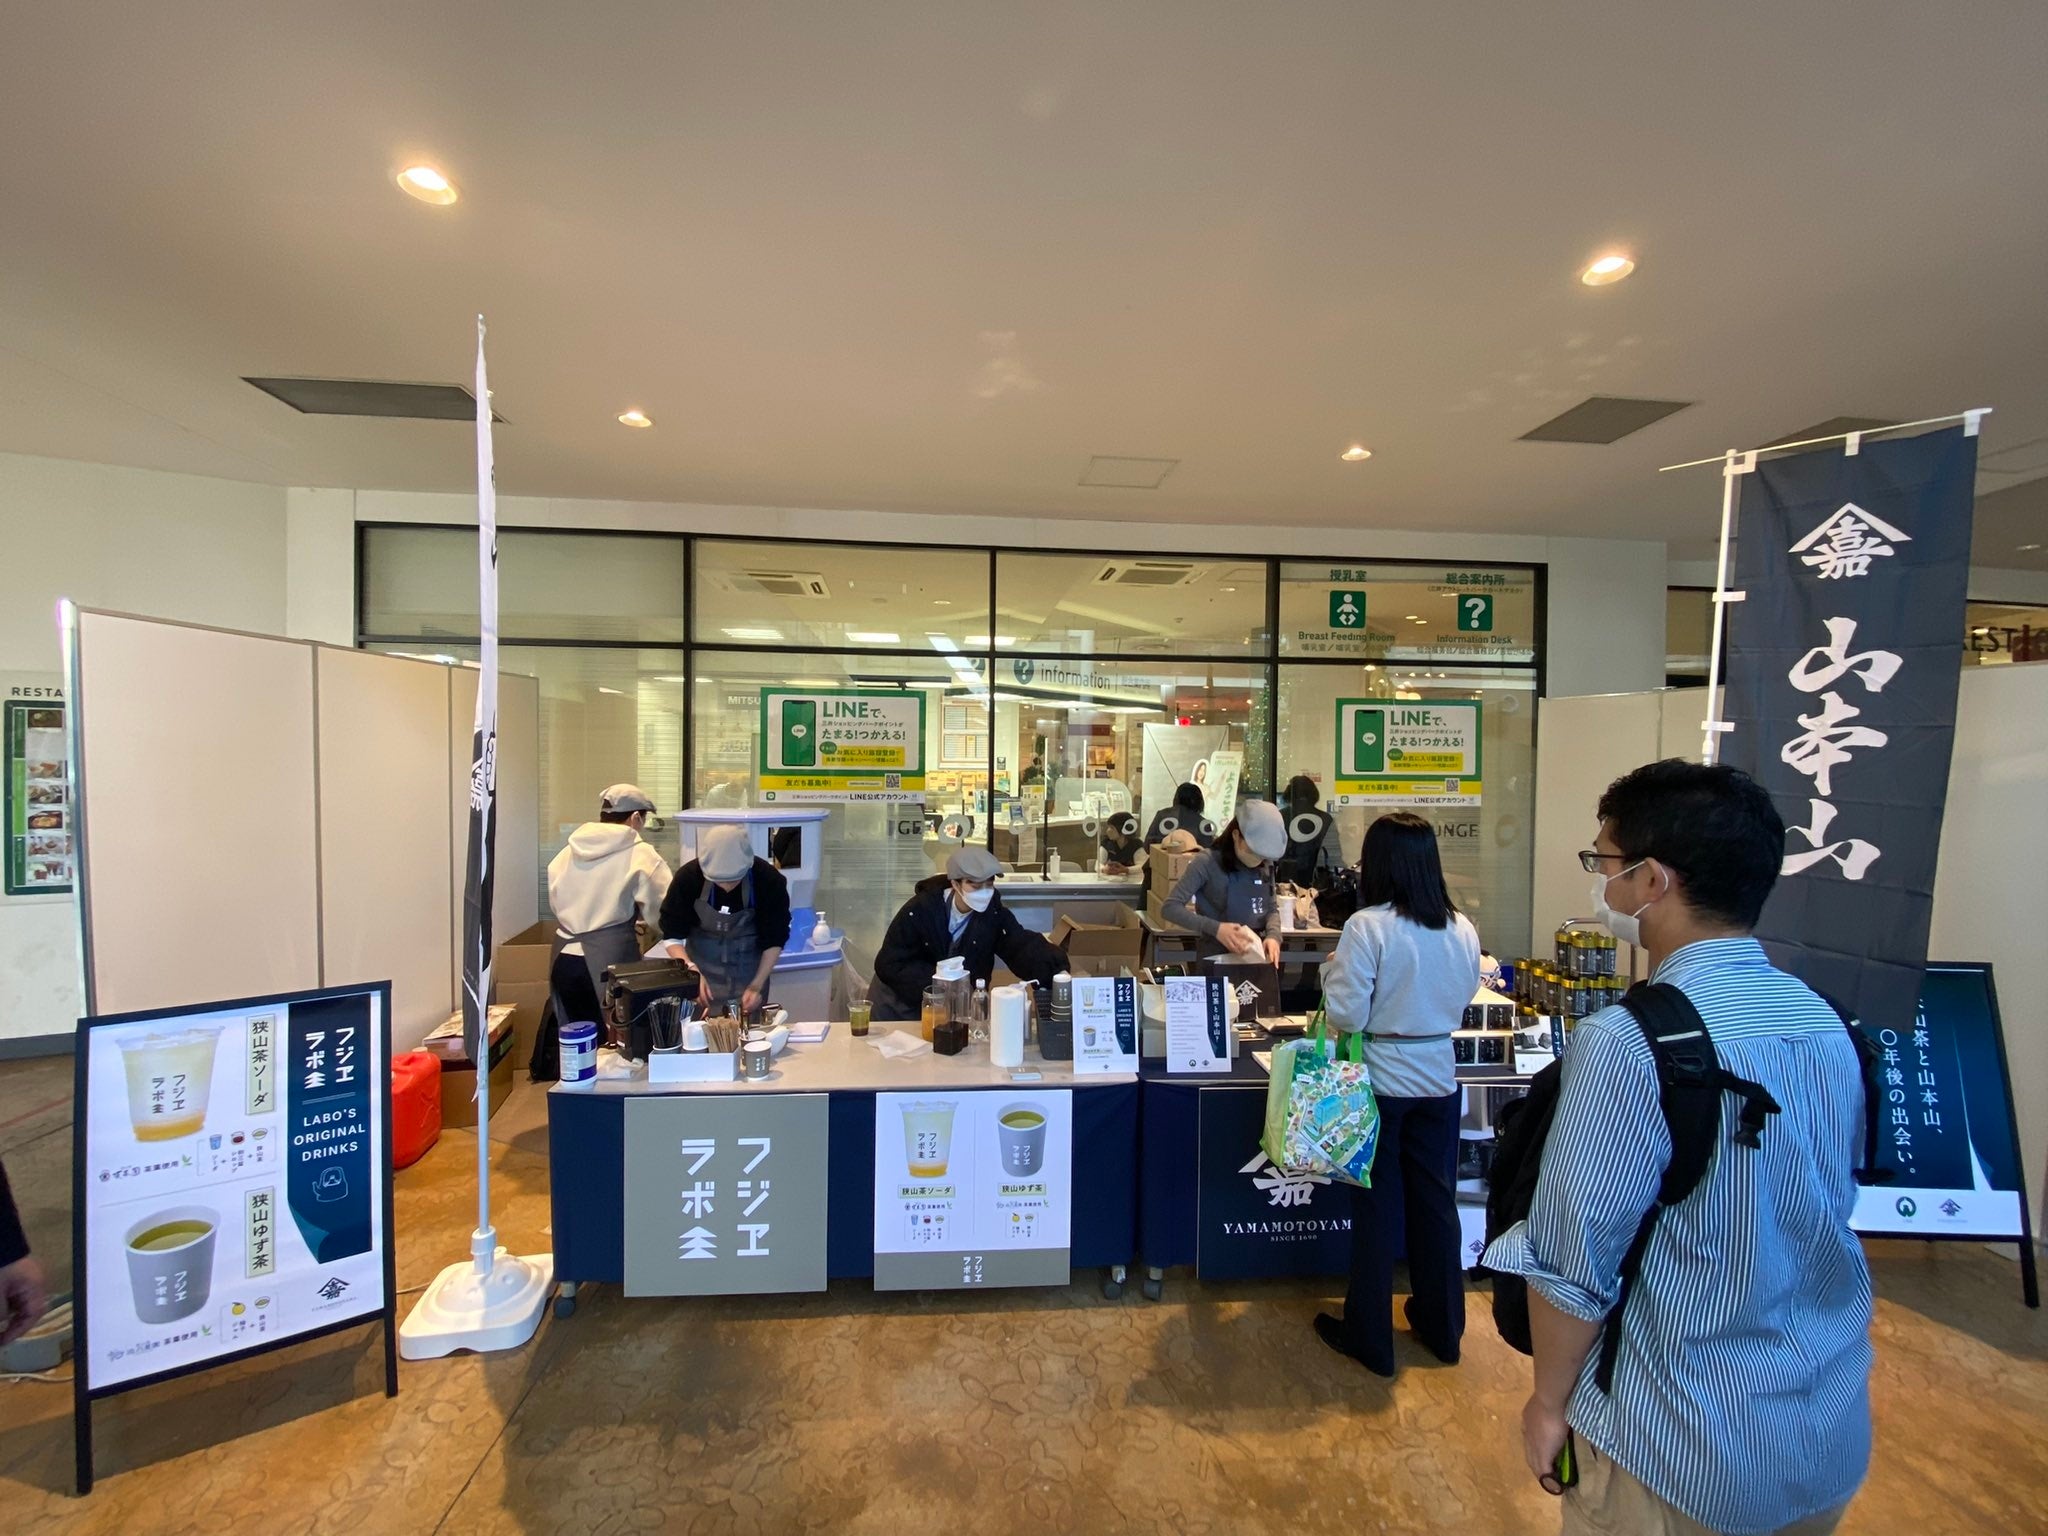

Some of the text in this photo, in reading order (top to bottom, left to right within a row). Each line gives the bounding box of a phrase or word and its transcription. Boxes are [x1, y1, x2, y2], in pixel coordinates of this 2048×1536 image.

[1330, 569, 1367, 582] 授乳室
[1445, 573, 1505, 586] 総合案内所
[1298, 631, 1396, 643] Breast Feeding Room
[1436, 634, 1513, 645] Information Desk
[1962, 625, 2018, 653] EST
[1041, 664, 1110, 690] information
[822, 701, 887, 719] LINEで、
[1390, 711, 1447, 726] LINEで、
[821, 728, 906, 741] たまる!つかえる!
[1389, 736, 1464, 747] たまる!つかえる!
[1781, 617, 1903, 880] 山本山
[785, 779, 832, 788] 友だち募集中!
[849, 793, 909, 801] LINE公式アカウント
[252, 1021, 269, 1108] 狭山茶ソーダ
[1911, 998, 1943, 1135] 山茶と山本山、
[303, 1107, 357, 1127] LABO'S
[294, 1123, 366, 1146] ORIGINAL
[302, 1140, 358, 1162] DRINKS
[902, 1186, 952, 1196] 狭山茶ソーダ
[1001, 1184, 1043, 1193] 狭山ゆず茶
[252, 1193, 269, 1270] 狭山ゆず茶
[1270, 1234, 1296, 1243] SINCE
